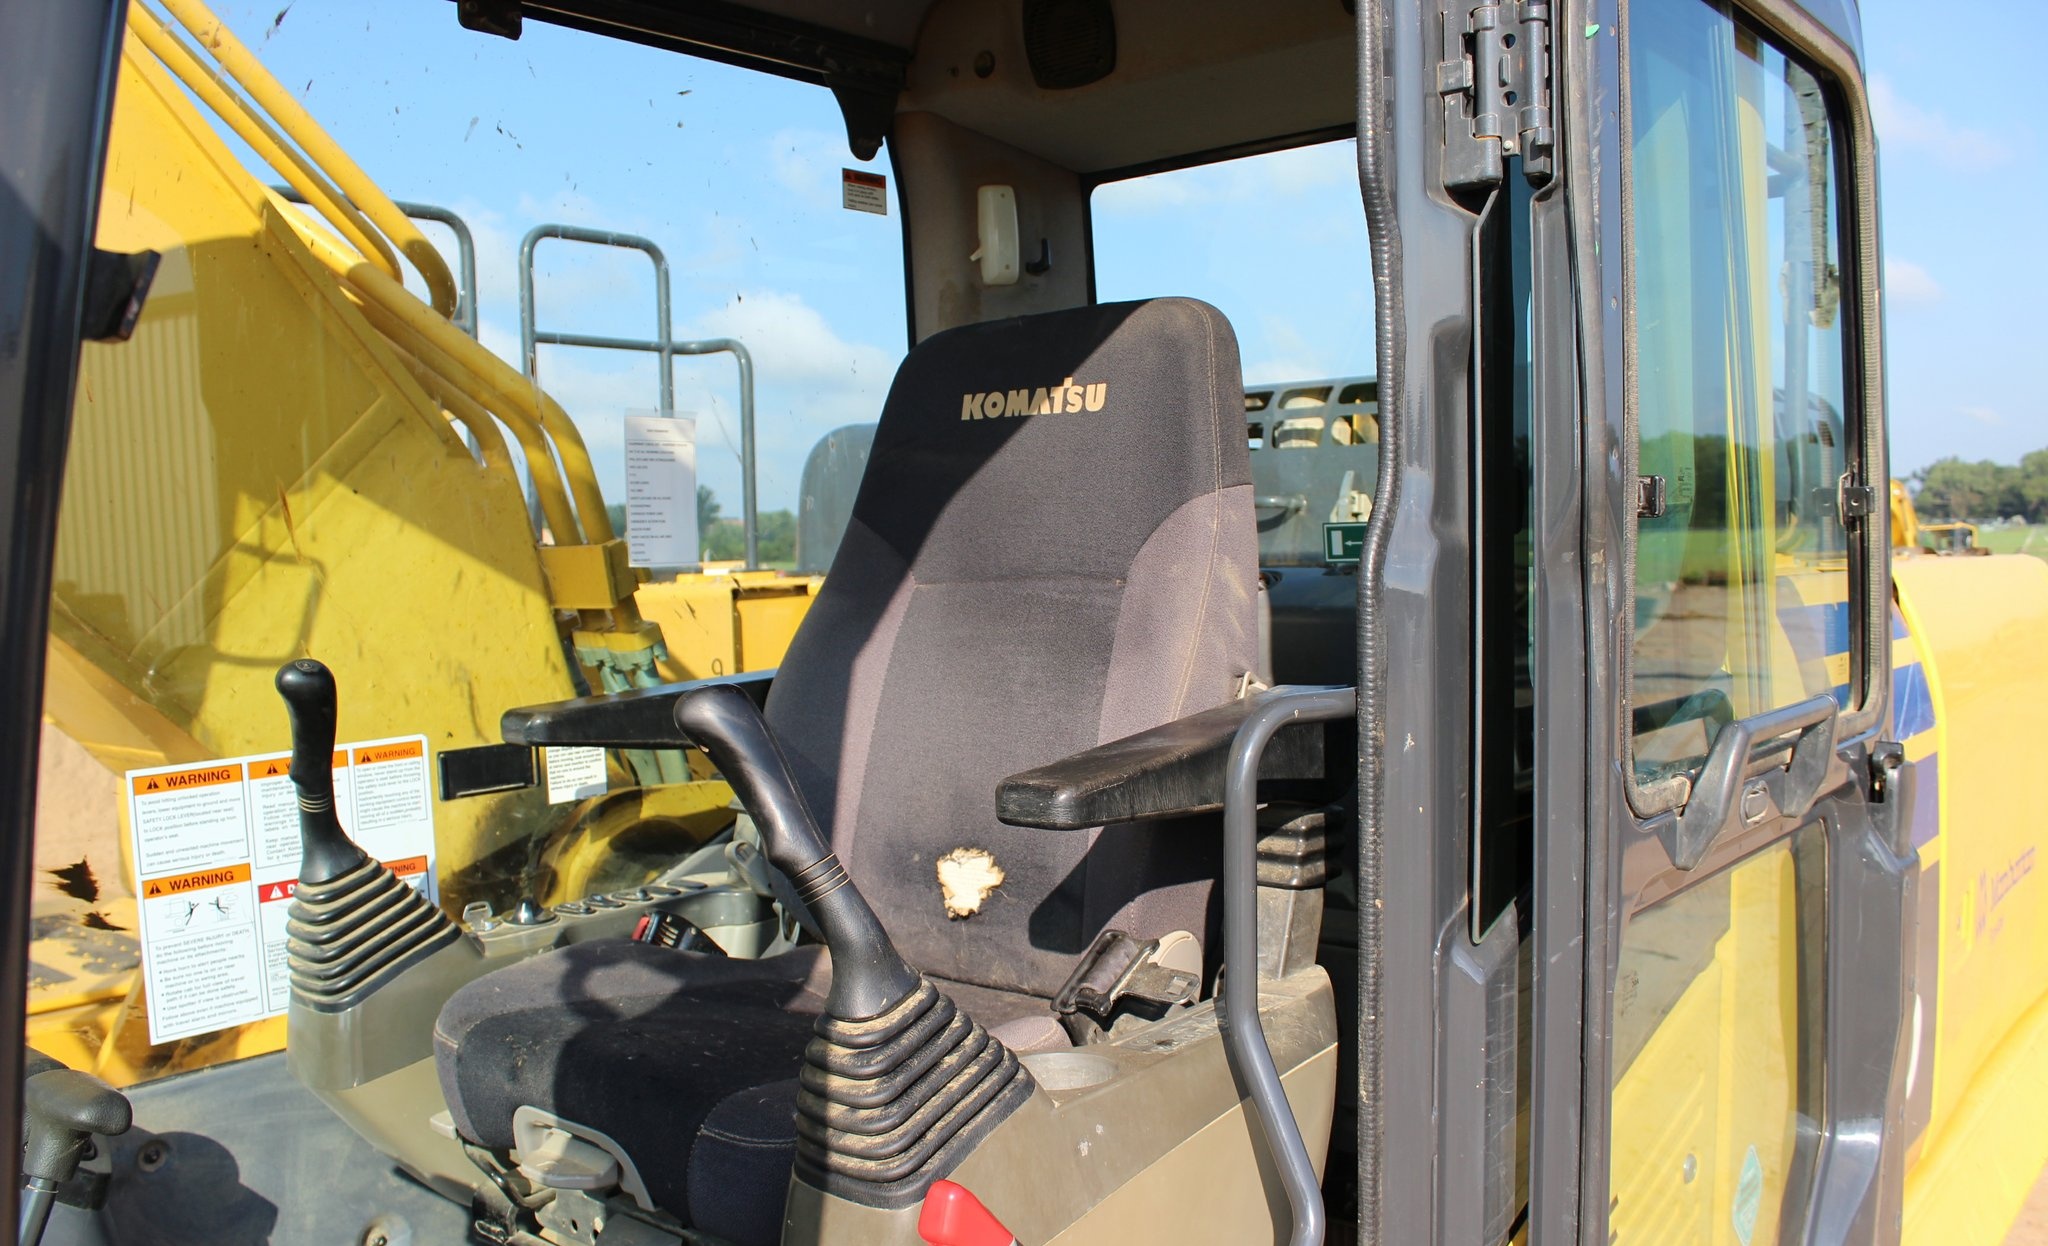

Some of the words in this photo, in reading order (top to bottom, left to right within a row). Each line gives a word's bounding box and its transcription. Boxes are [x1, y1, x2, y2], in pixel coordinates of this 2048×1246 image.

[961, 377, 1107, 420] KOMATSU
[375, 748, 415, 759] WARNING
[166, 769, 231, 787] WARNING
[169, 870, 234, 891] WARNING
